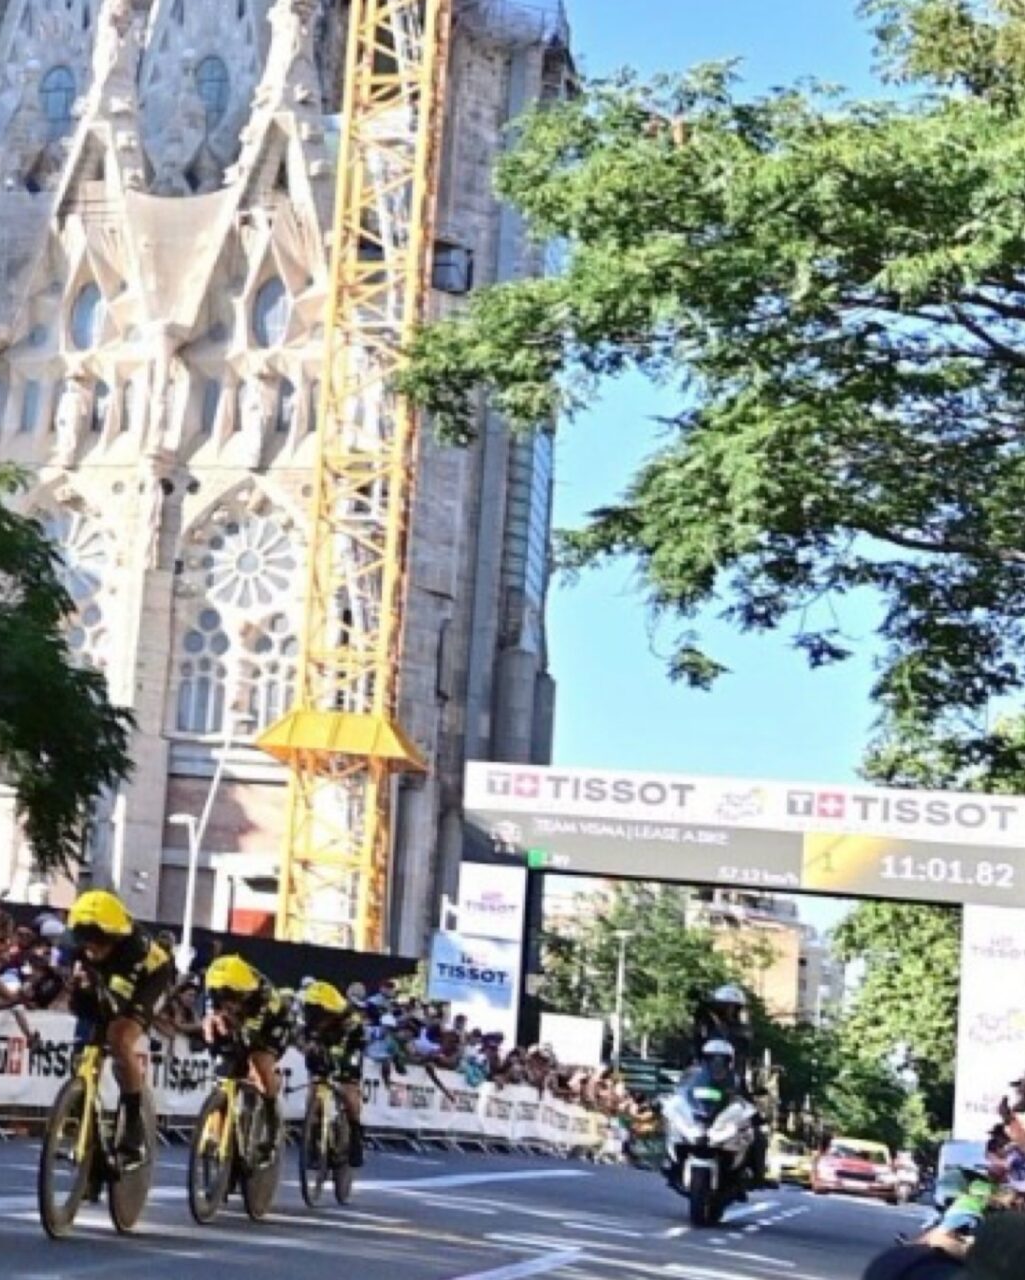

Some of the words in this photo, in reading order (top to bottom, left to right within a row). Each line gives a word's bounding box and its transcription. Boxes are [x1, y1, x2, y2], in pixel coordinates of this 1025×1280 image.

[546, 775, 695, 807] TISSOT
[853, 795, 1018, 831] TISSOT
[881, 854, 1014, 887] 11:01.82
[437, 963, 508, 983] TISSOT
